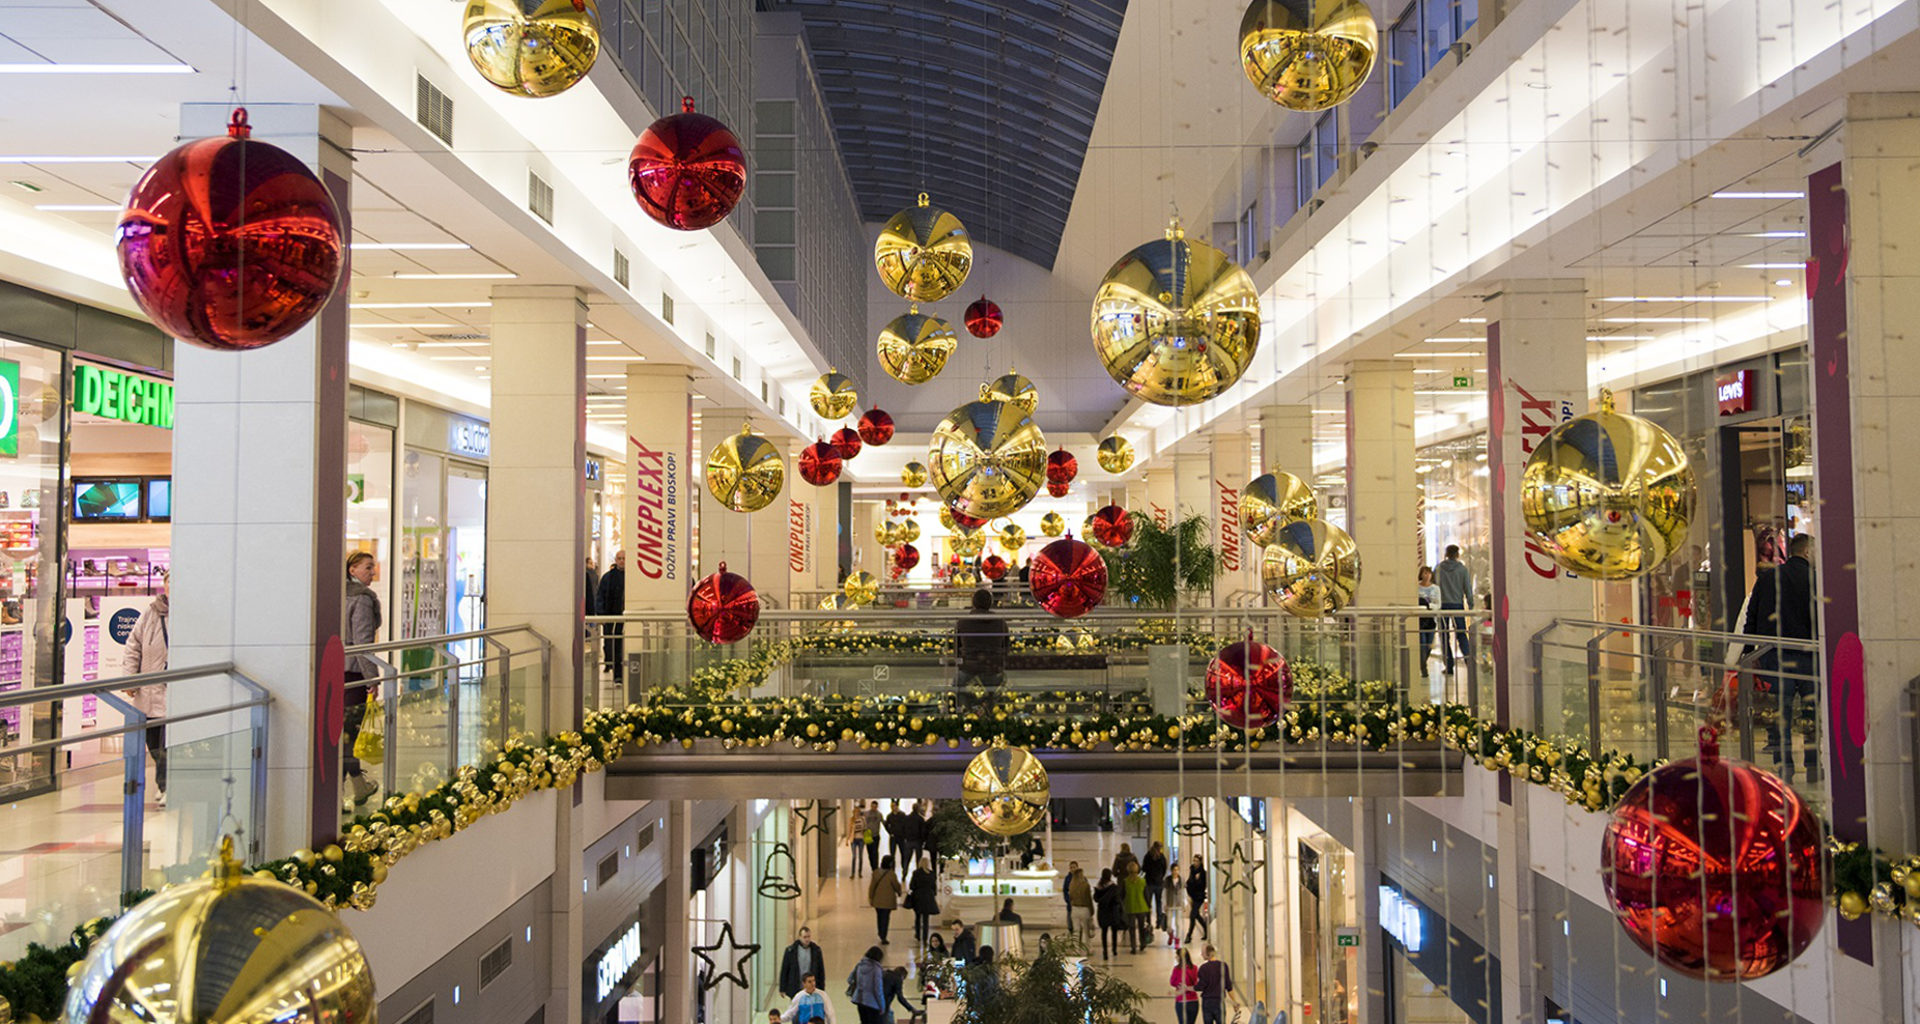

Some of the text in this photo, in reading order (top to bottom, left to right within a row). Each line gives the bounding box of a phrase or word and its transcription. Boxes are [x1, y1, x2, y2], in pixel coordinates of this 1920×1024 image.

[630, 435, 663, 580] CINEPLEXX
[666, 452, 676, 580] DOŽIVI PRAVI BIOSKOP!
[790, 499, 804, 572] CINEPLEXX
[1216, 479, 1239, 571] CINEPLEXX
